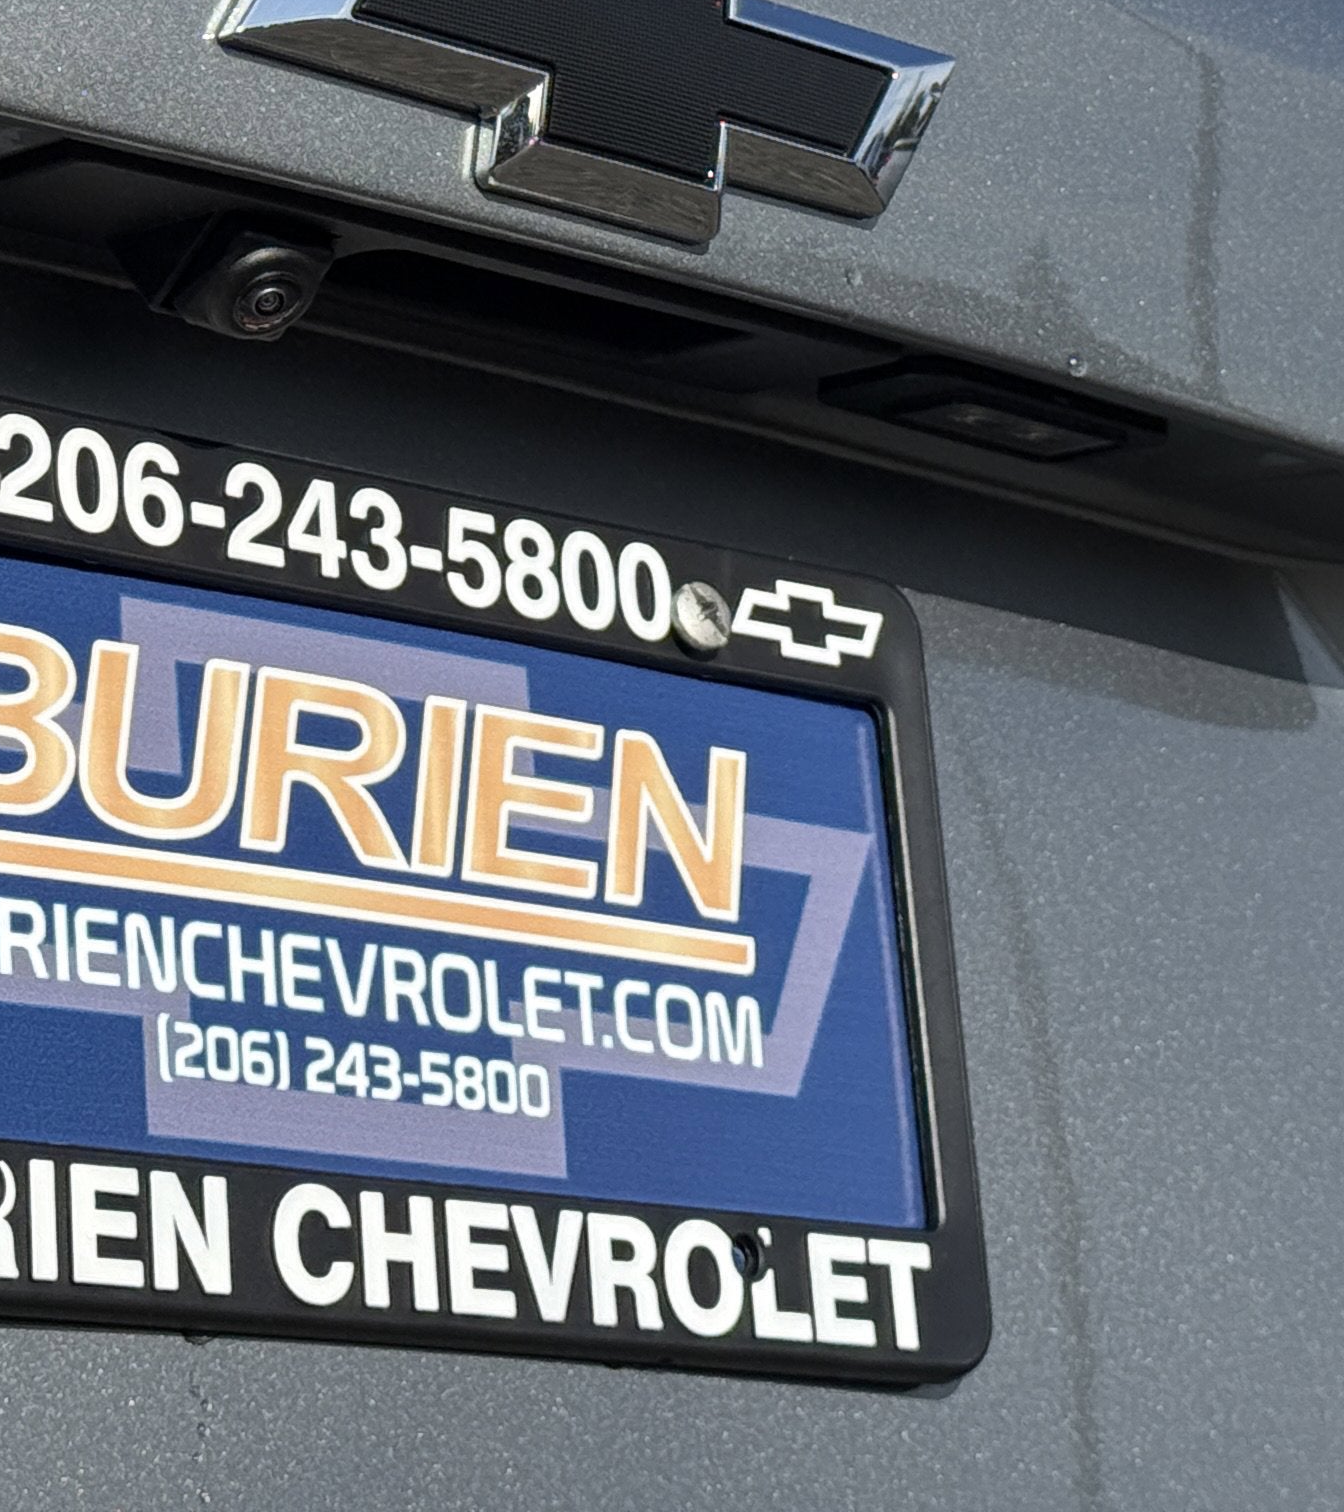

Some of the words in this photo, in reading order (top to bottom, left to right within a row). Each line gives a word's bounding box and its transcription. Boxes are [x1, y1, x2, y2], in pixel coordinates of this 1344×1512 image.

[157, 1013, 290, 1090] (206)
[305, 1036, 551, 1118] 243-5800
[273, 1183, 932, 1351] CHEVROLET
